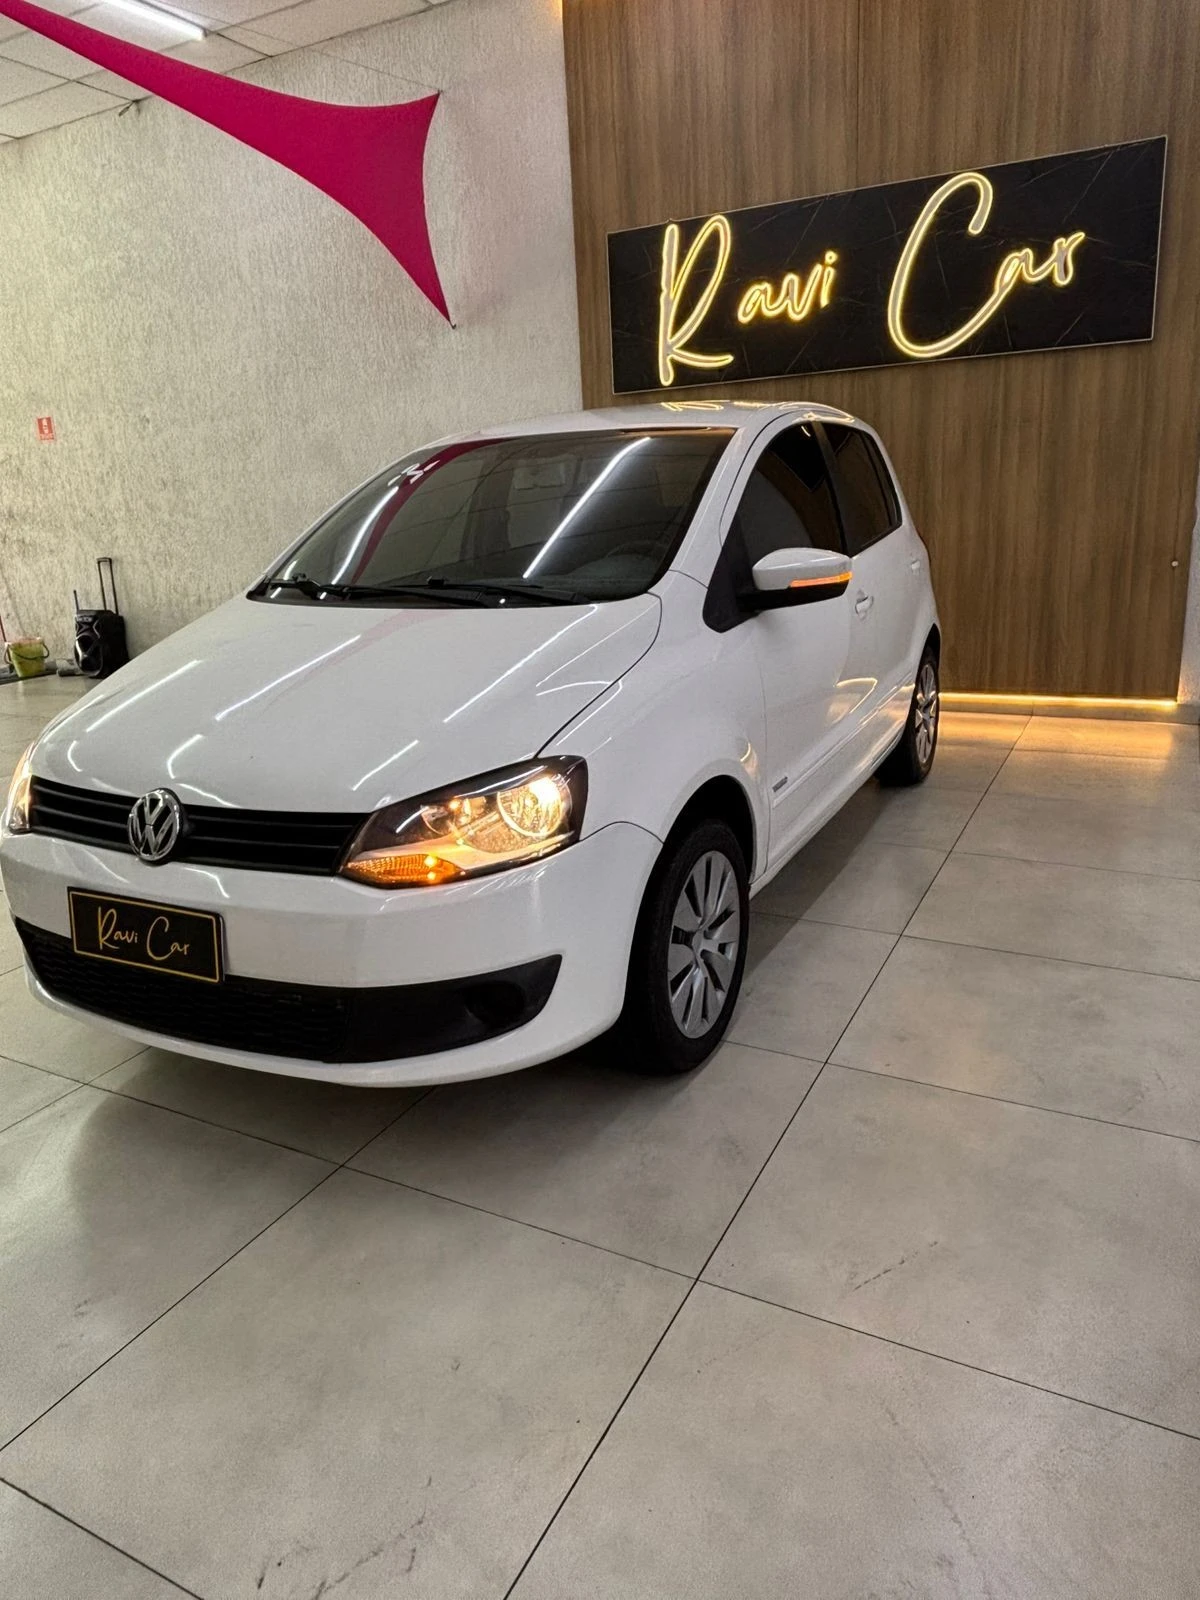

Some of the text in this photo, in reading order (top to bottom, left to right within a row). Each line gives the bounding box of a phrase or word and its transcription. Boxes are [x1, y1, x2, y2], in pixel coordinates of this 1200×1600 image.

[659, 171, 1086, 386] Ravi Car
[98, 906, 190, 960] Ravi Car
